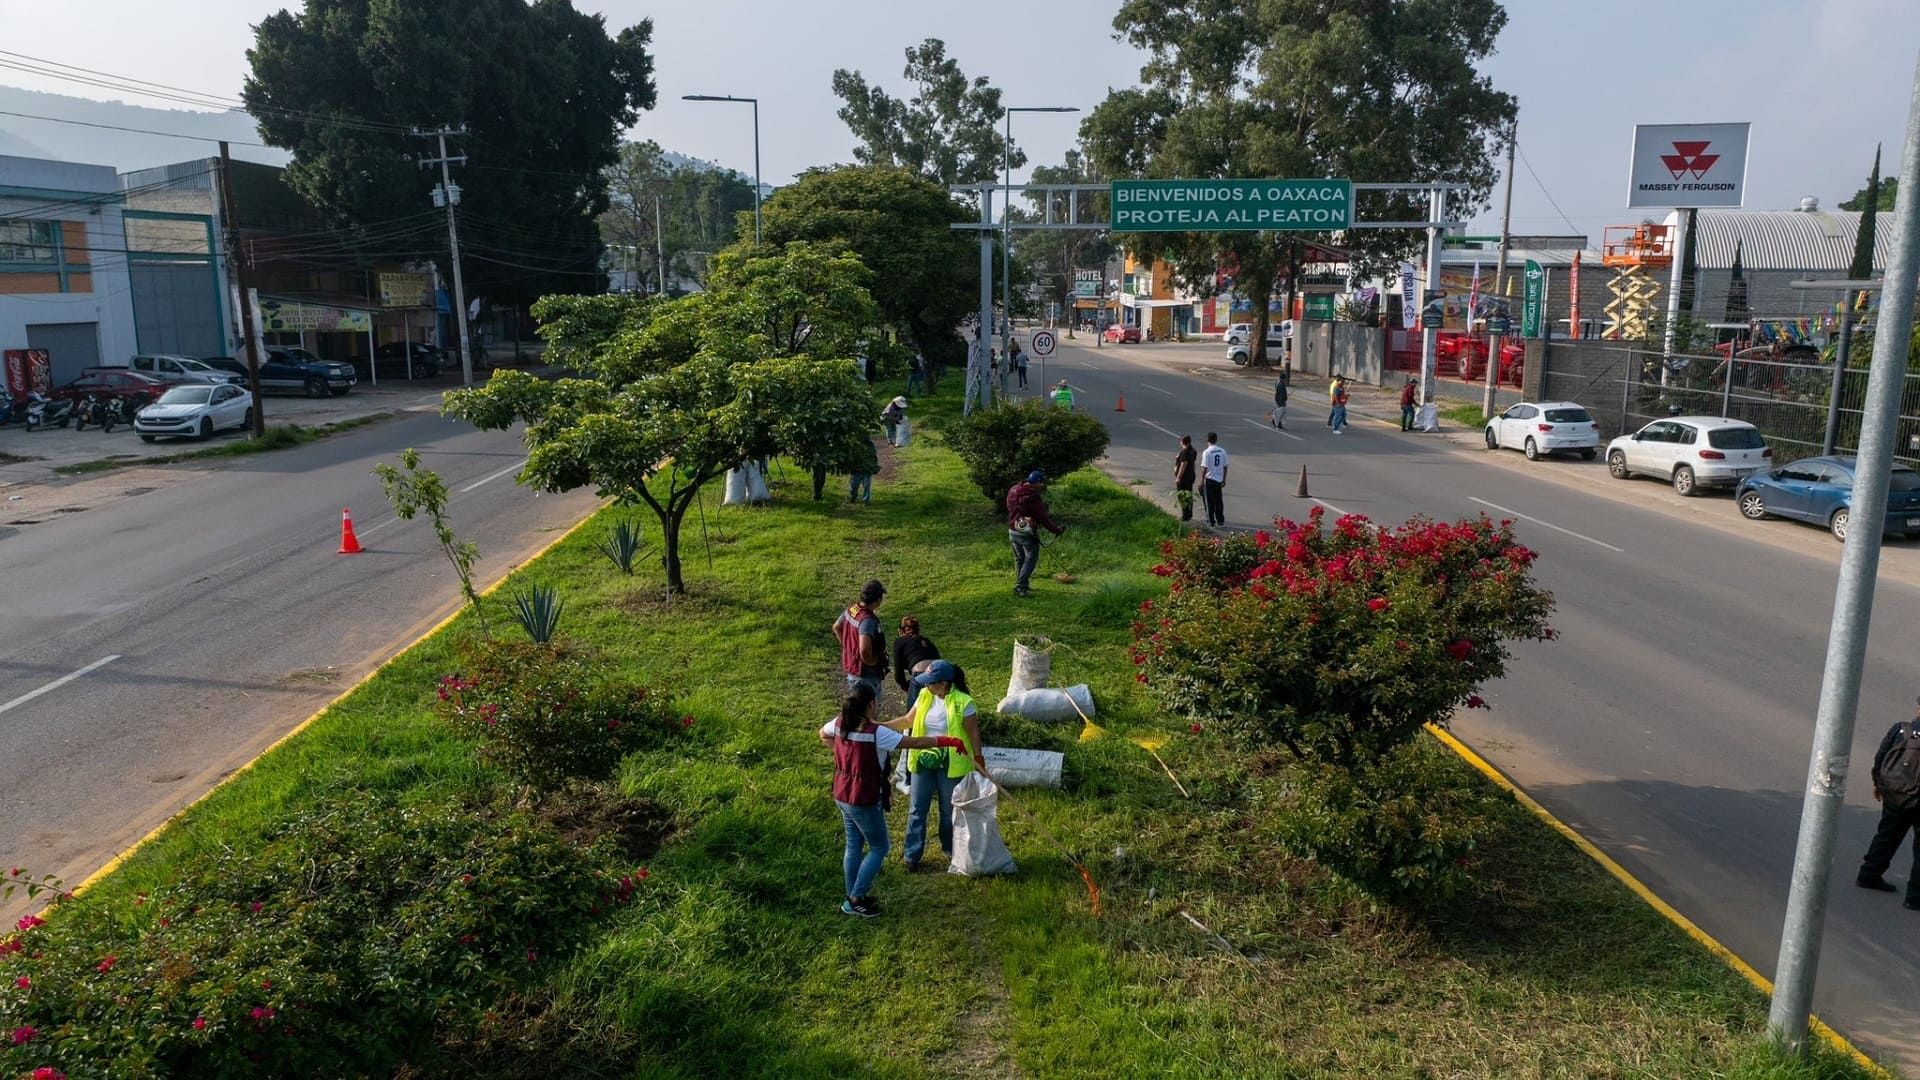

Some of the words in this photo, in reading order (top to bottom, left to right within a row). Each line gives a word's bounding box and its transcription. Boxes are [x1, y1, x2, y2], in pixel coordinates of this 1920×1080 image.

[1639, 183, 1680, 192] MASSEY
[1682, 183, 1735, 192] FERGUSON
[1117, 188, 1243, 202] BIENVENIDOS
[1248, 188, 1262, 201] A
[1267, 188, 1345, 201] OAXACA
[1117, 210, 1220, 223] PROTEJA
[1224, 210, 1253, 223] AL
[1257, 209, 1345, 223] PEATON
[1075, 270, 1103, 281] HOTEL
[1527, 282, 1538, 331] AGRICULTURE
[1038, 336, 1050, 347] 60
